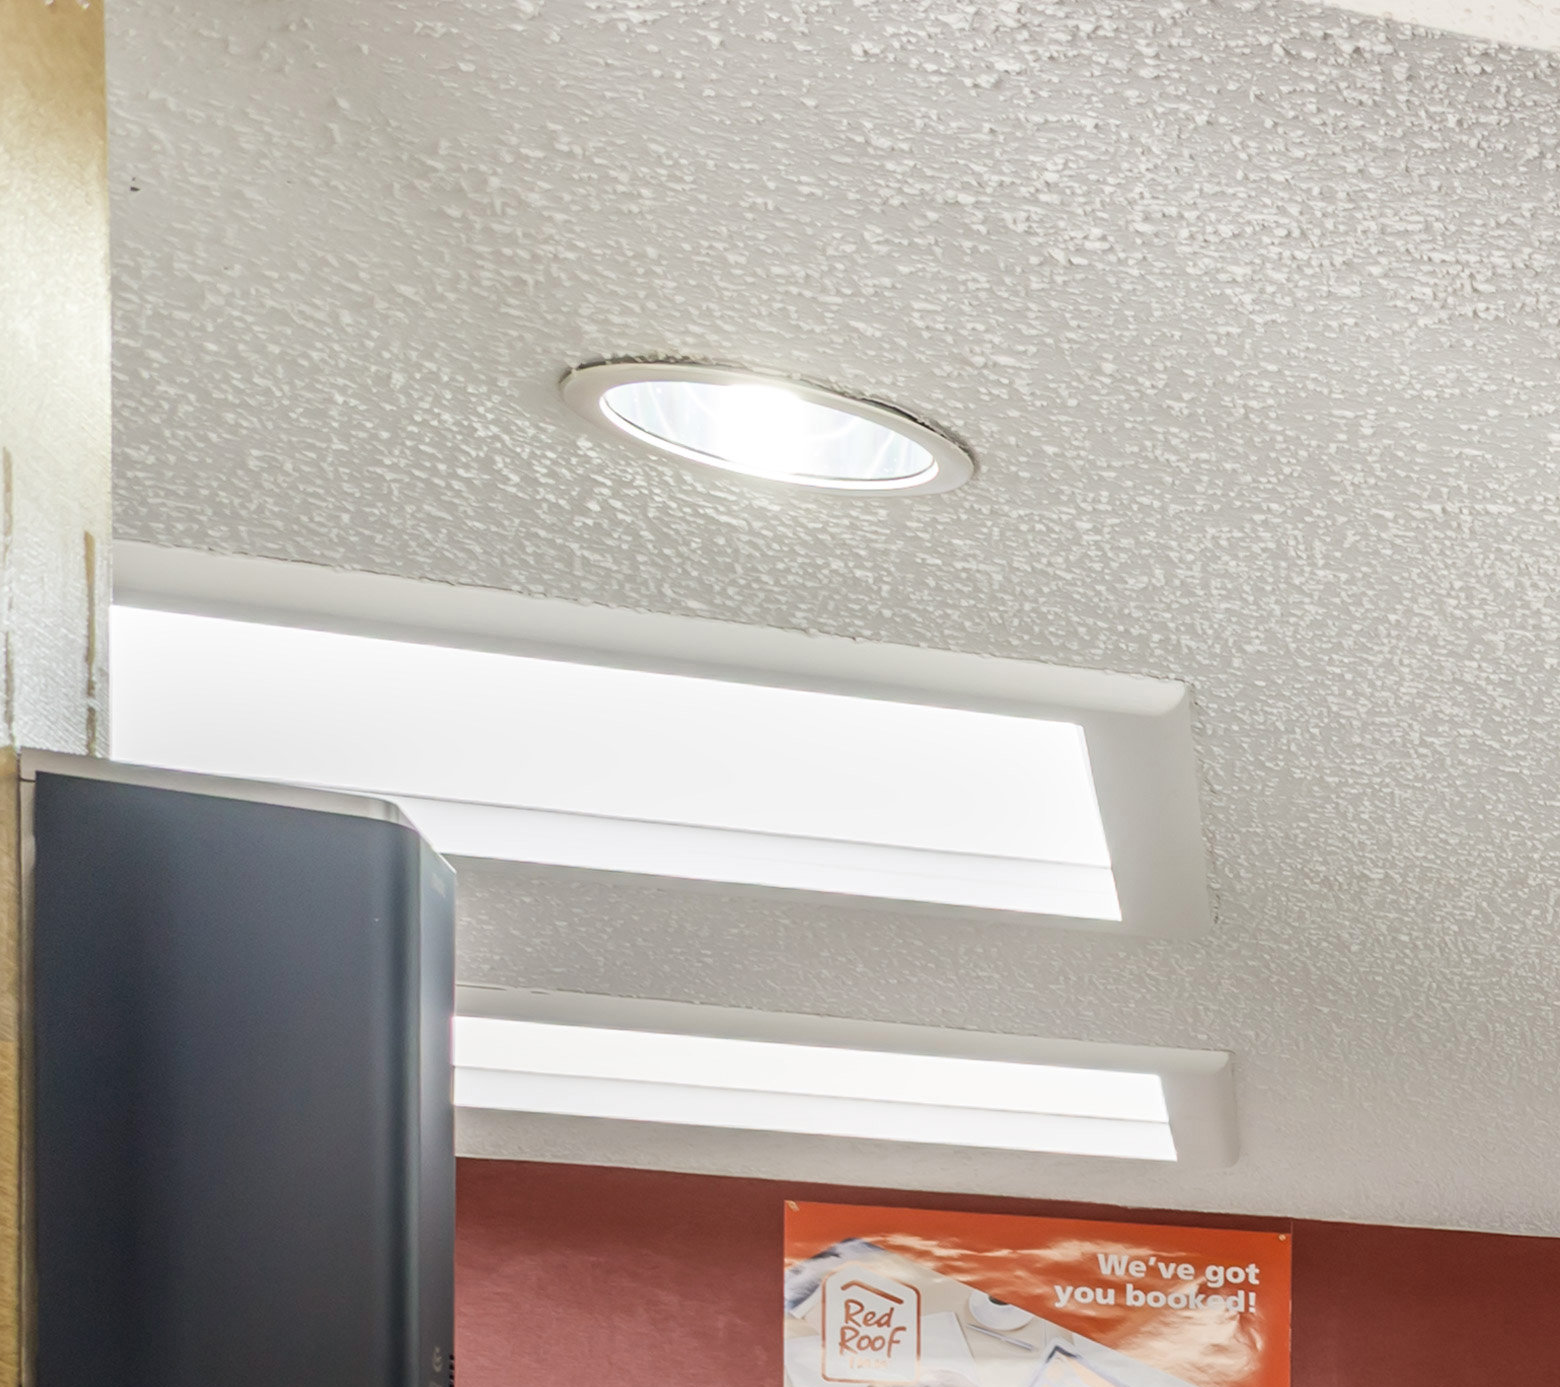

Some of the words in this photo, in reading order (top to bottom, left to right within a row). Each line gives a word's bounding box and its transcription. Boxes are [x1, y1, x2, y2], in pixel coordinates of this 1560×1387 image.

[1204, 1264, 1259, 1288] got
[1054, 1284, 1115, 1308] you
[1125, 1282, 1257, 1314] booked!
[842, 1299, 894, 1329] Red
[838, 1326, 908, 1359] Roof
